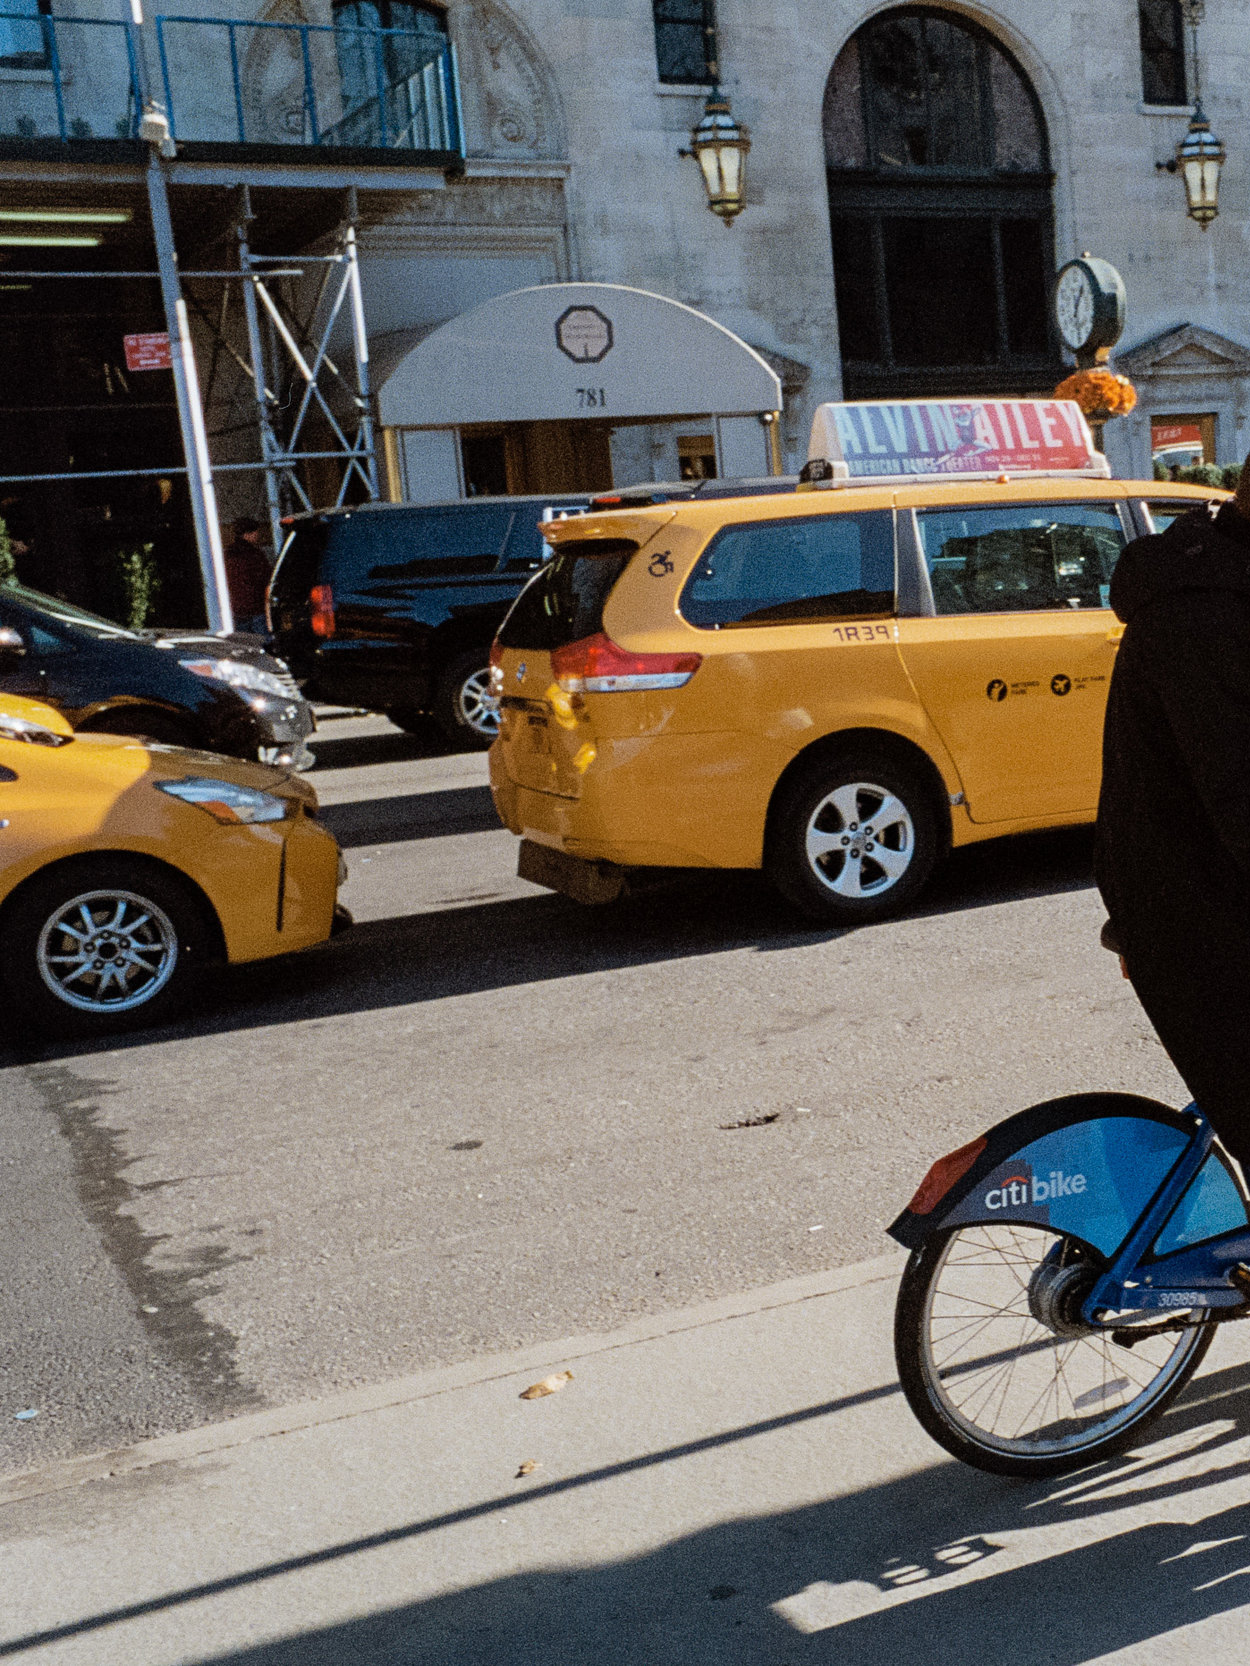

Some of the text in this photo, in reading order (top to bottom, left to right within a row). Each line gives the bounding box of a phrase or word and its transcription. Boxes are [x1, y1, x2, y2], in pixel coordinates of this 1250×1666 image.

[575, 387, 606, 407] 781
[833, 402, 1085, 453] ALVIN AILEY
[847, 459, 902, 475] AMERICAN
[832, 625, 890, 641] 1R39
